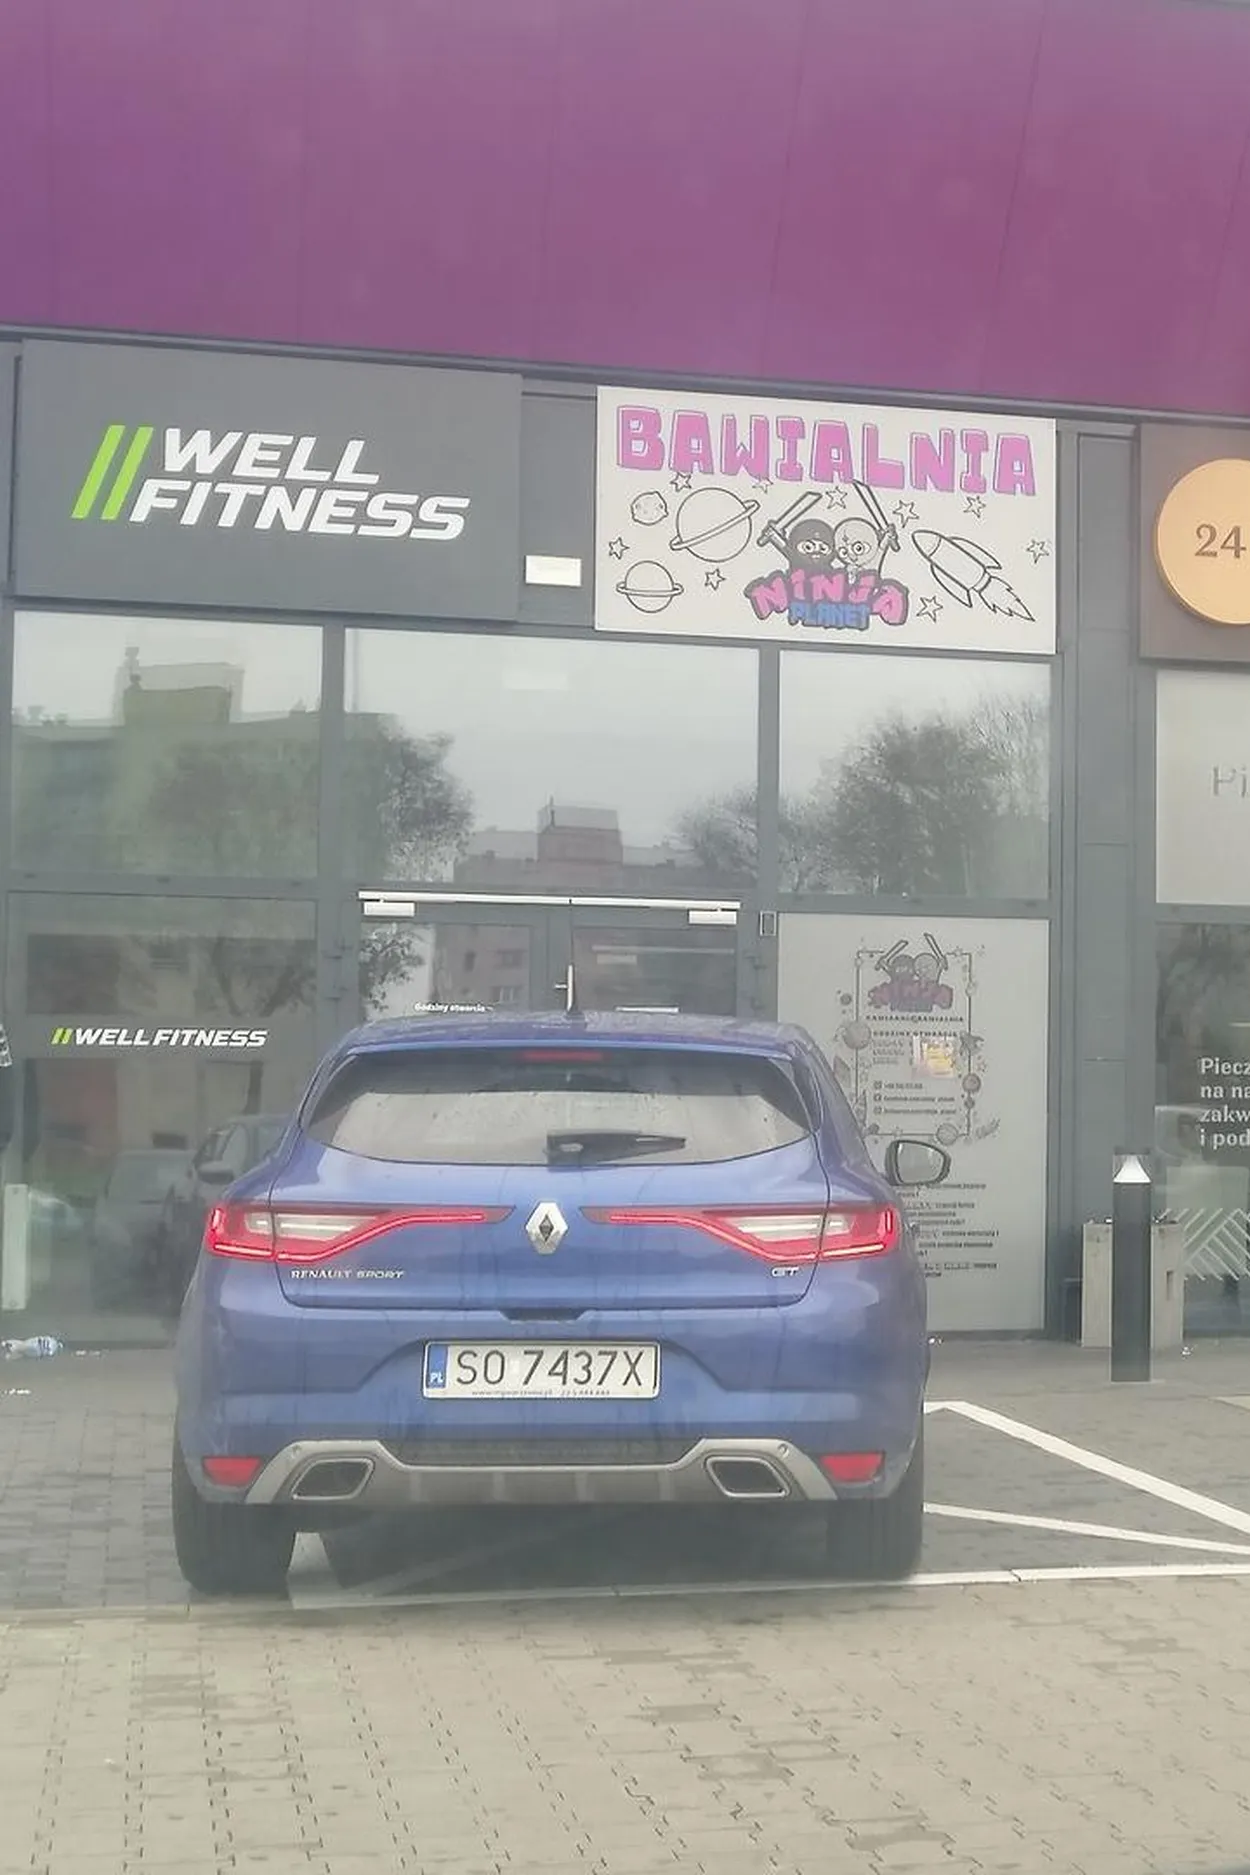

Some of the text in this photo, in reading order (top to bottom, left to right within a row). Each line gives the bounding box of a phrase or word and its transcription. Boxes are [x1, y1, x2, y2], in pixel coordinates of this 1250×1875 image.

[163, 427, 380, 484] WELL
[616, 404, 1036, 496] BAWIALNIA
[129, 478, 471, 540] FITNESS
[789, 602, 870, 628] PLANET
[75, 1028, 268, 1047] WELL FITNESS
[1200, 1085, 1224, 1099] na
[1200, 1128, 1206, 1147] i
[290, 1269, 405, 1279] RENAULT SPORT
[771, 1266, 800, 1277] GT
[429, 1372, 445, 1383] PL
[456, 1349, 644, 1387] SO 7437X
